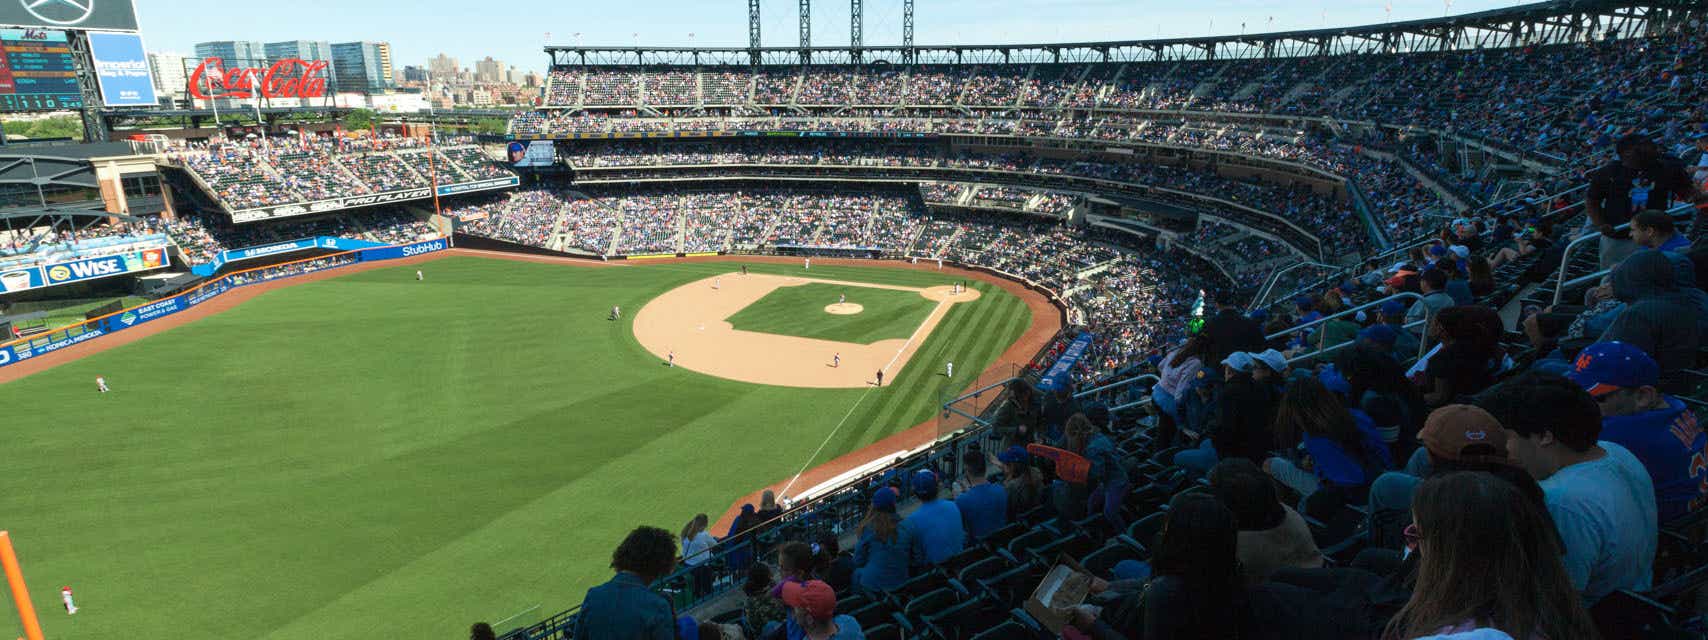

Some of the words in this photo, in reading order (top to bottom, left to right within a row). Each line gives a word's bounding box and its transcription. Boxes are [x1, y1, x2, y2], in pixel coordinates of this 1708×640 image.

[21, 28, 48, 40] Mets
[344, 196, 376, 206] PRO
[377, 189, 430, 202] PLAYER
[402, 240, 443, 257] StubHub
[70, 258, 122, 278] WISE
[138, 304, 156, 314] EAST
[155, 298, 176, 309] COAST
[139, 309, 161, 320] POWER
[166, 304, 178, 312] GAS
[45, 338, 74, 352] KONICA
[74, 330, 104, 343] MINOLTA
